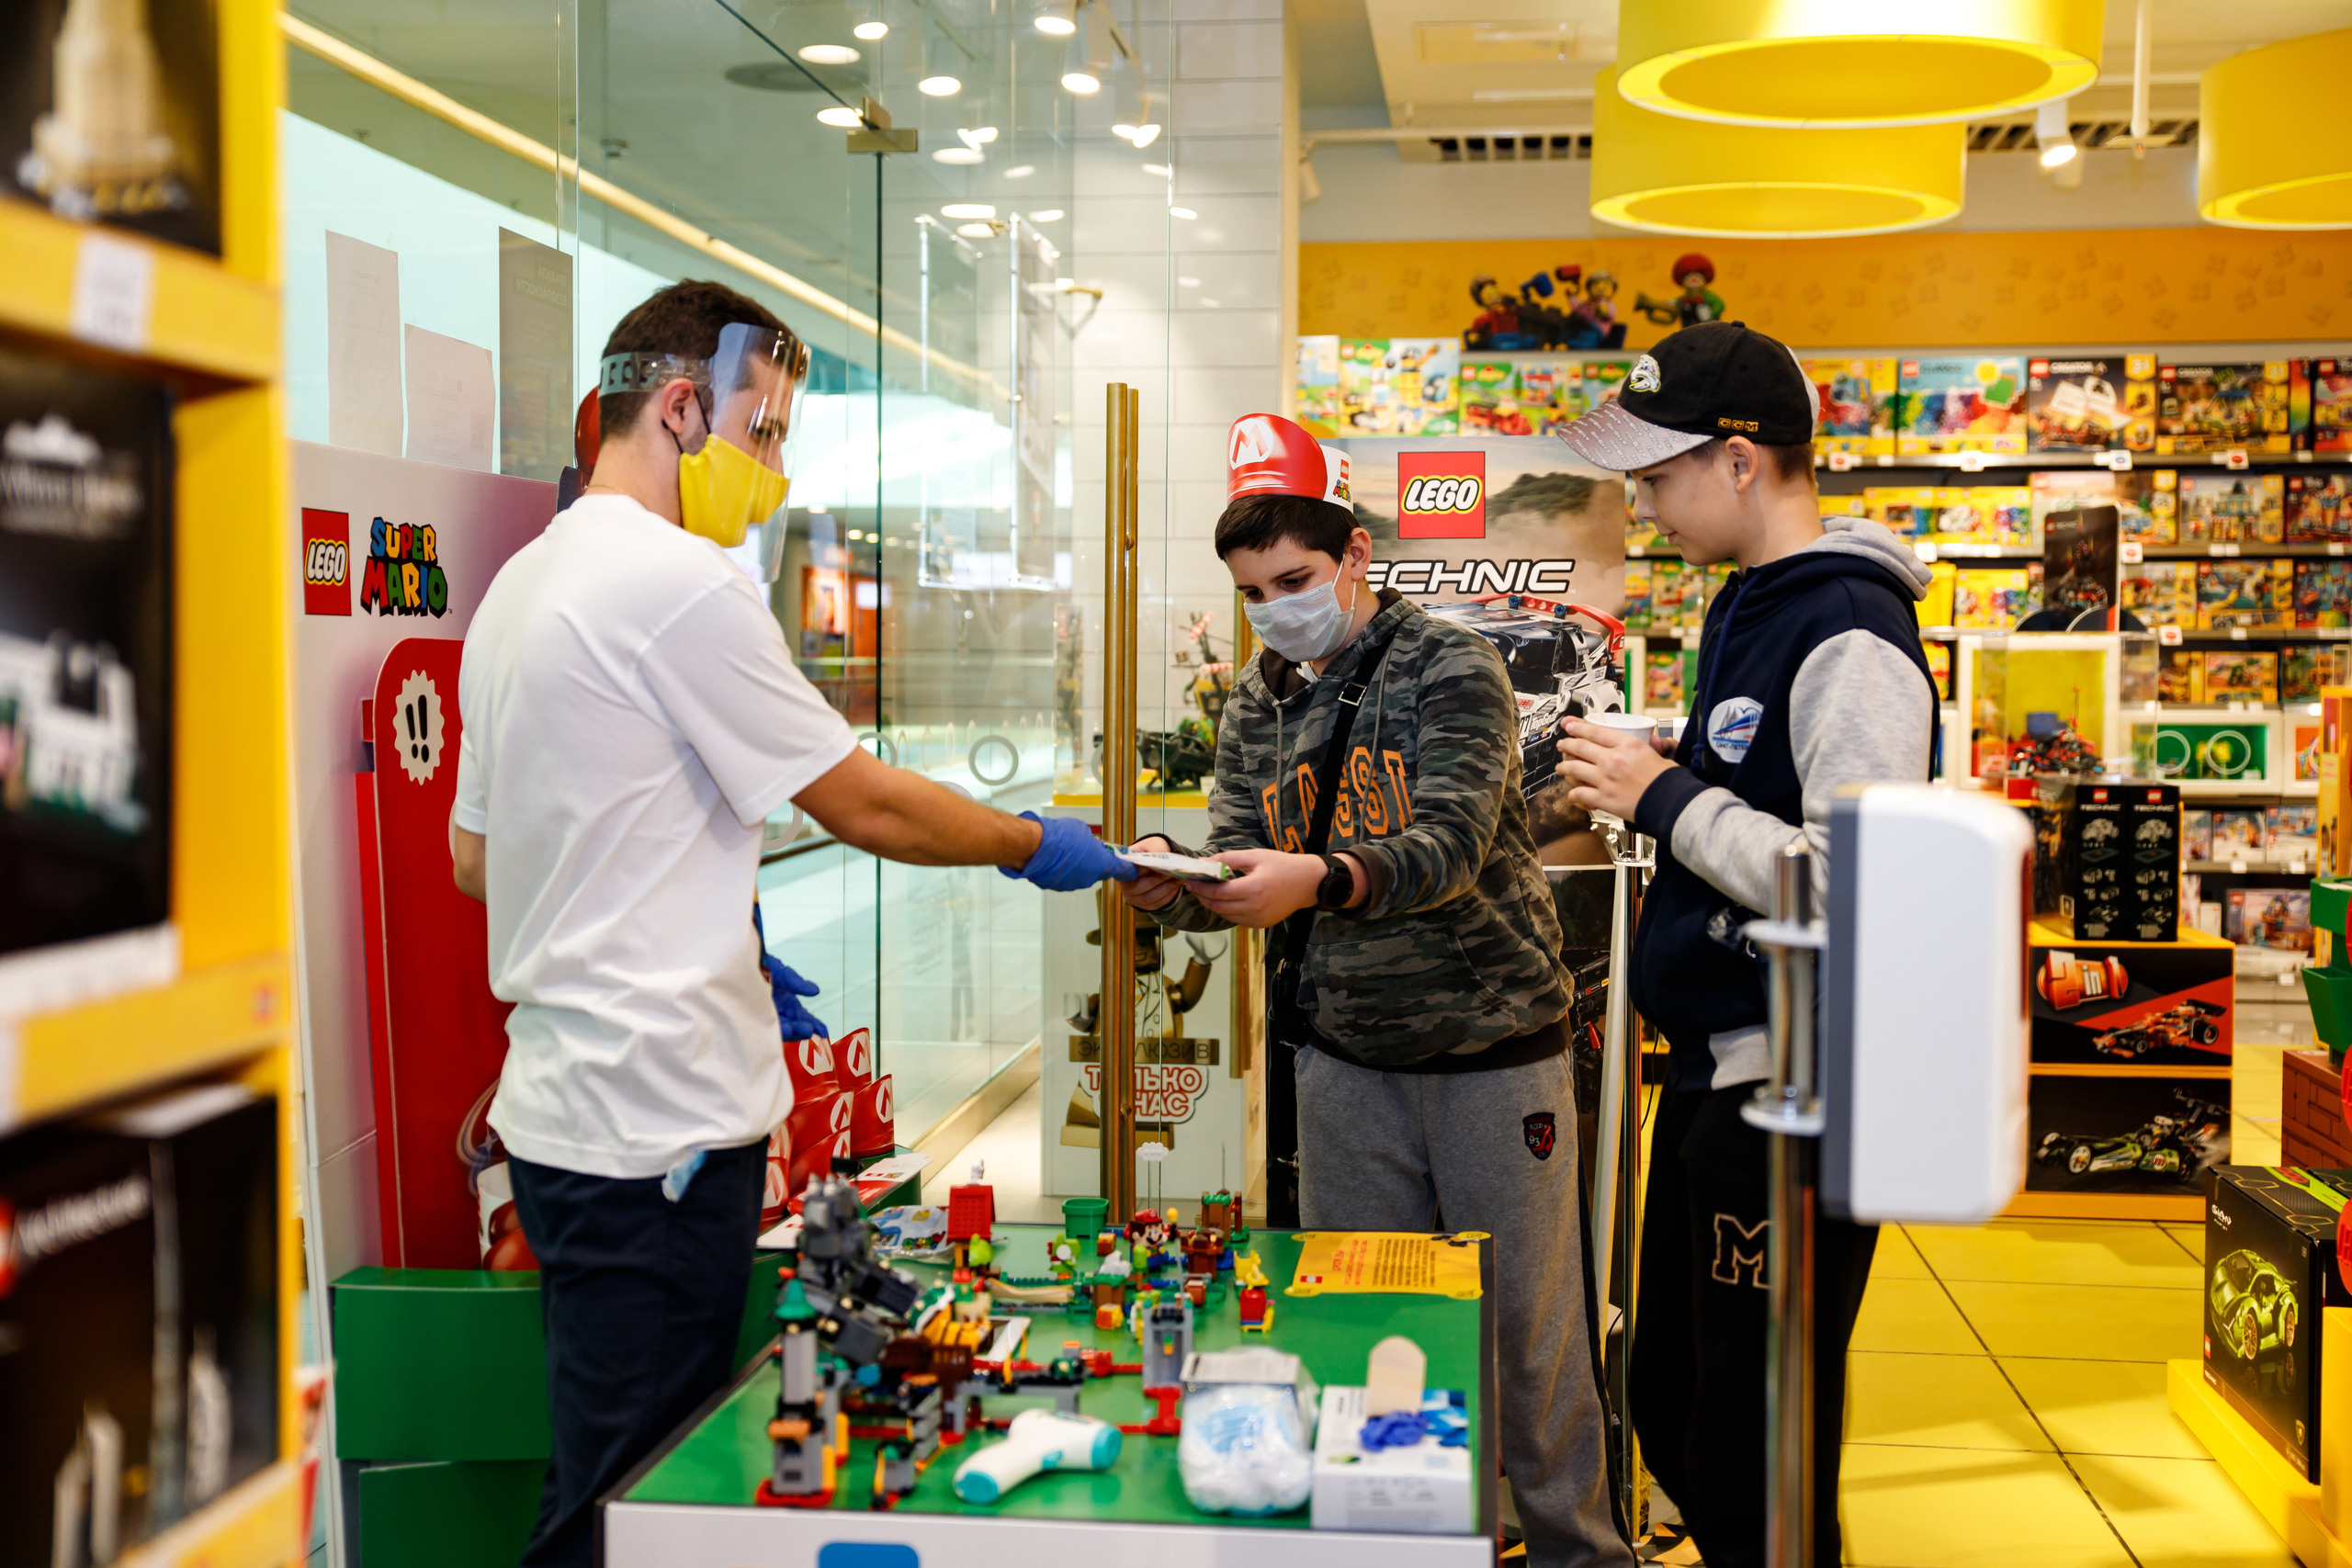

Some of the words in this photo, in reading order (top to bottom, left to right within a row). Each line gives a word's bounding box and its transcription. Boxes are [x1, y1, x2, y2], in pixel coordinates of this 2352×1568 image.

[1717, 417, 1759, 433] CCM
[1403, 477, 1482, 513] LEGO
[371, 516, 436, 562] SUPER
[305, 538, 348, 586] LEGO
[1365, 558, 1576, 594] ECHNIC
[360, 555, 448, 619] MARIO
[1529, 1135, 1541, 1146] 93
